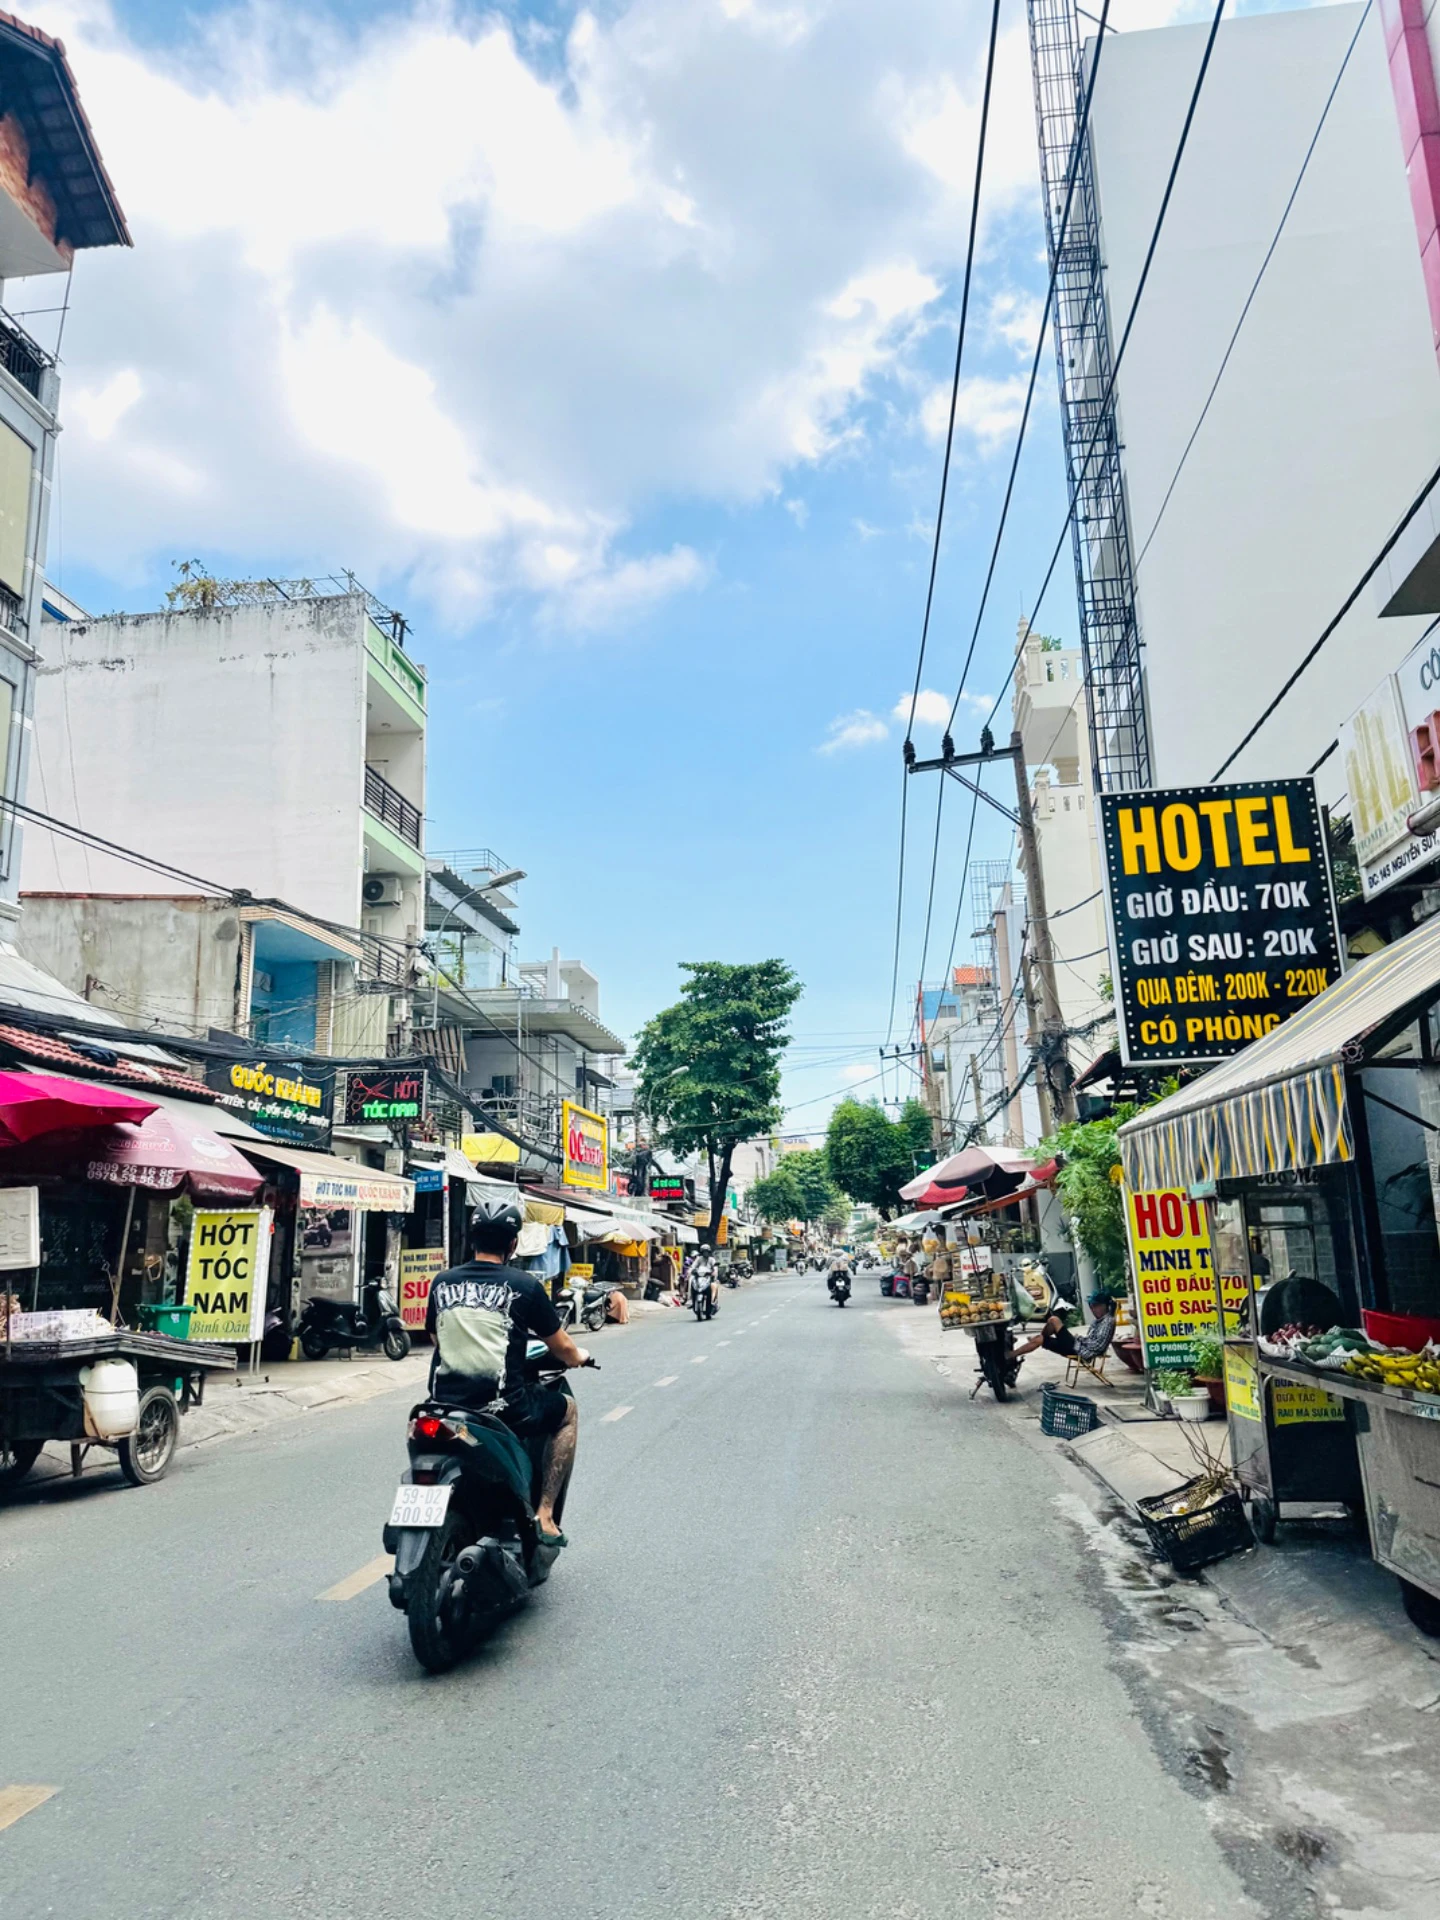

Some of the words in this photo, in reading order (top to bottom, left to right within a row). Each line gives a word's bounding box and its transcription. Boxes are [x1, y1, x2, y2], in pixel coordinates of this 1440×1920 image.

[1118, 795, 1311, 875] HOTEL
[1126, 884, 1173, 919] GIỜ
[1181, 878, 1249, 915] ĐẦU:
[1255, 881, 1311, 910] 70K
[1131, 930, 1179, 965] GIỜ
[1263, 928, 1318, 957] 20K
[1136, 976, 1172, 1008] QUA
[1175, 970, 1221, 1003] ĐÊM:
[1224, 972, 1270, 1000] 200K
[1285, 968, 1328, 997] 220K
[1140, 1014, 1178, 1045] CÓ
[1186, 1009, 1280, 1042] PHÒNG
[230, 1061, 274, 1096] QUỐC
[200, 1216, 254, 1246] HỚT
[1134, 1192, 1210, 1239] HOT
[198, 1250, 248, 1279] TÓC
[1138, 1249, 1192, 1272] MINH
[1196, 1248, 1214, 1269] T
[1143, 1275, 1171, 1294] GIỜ
[193, 1292, 248, 1314] NAM
[1145, 1298, 1174, 1316] GIỜ
[1147, 1324, 1168, 1339] QUA
